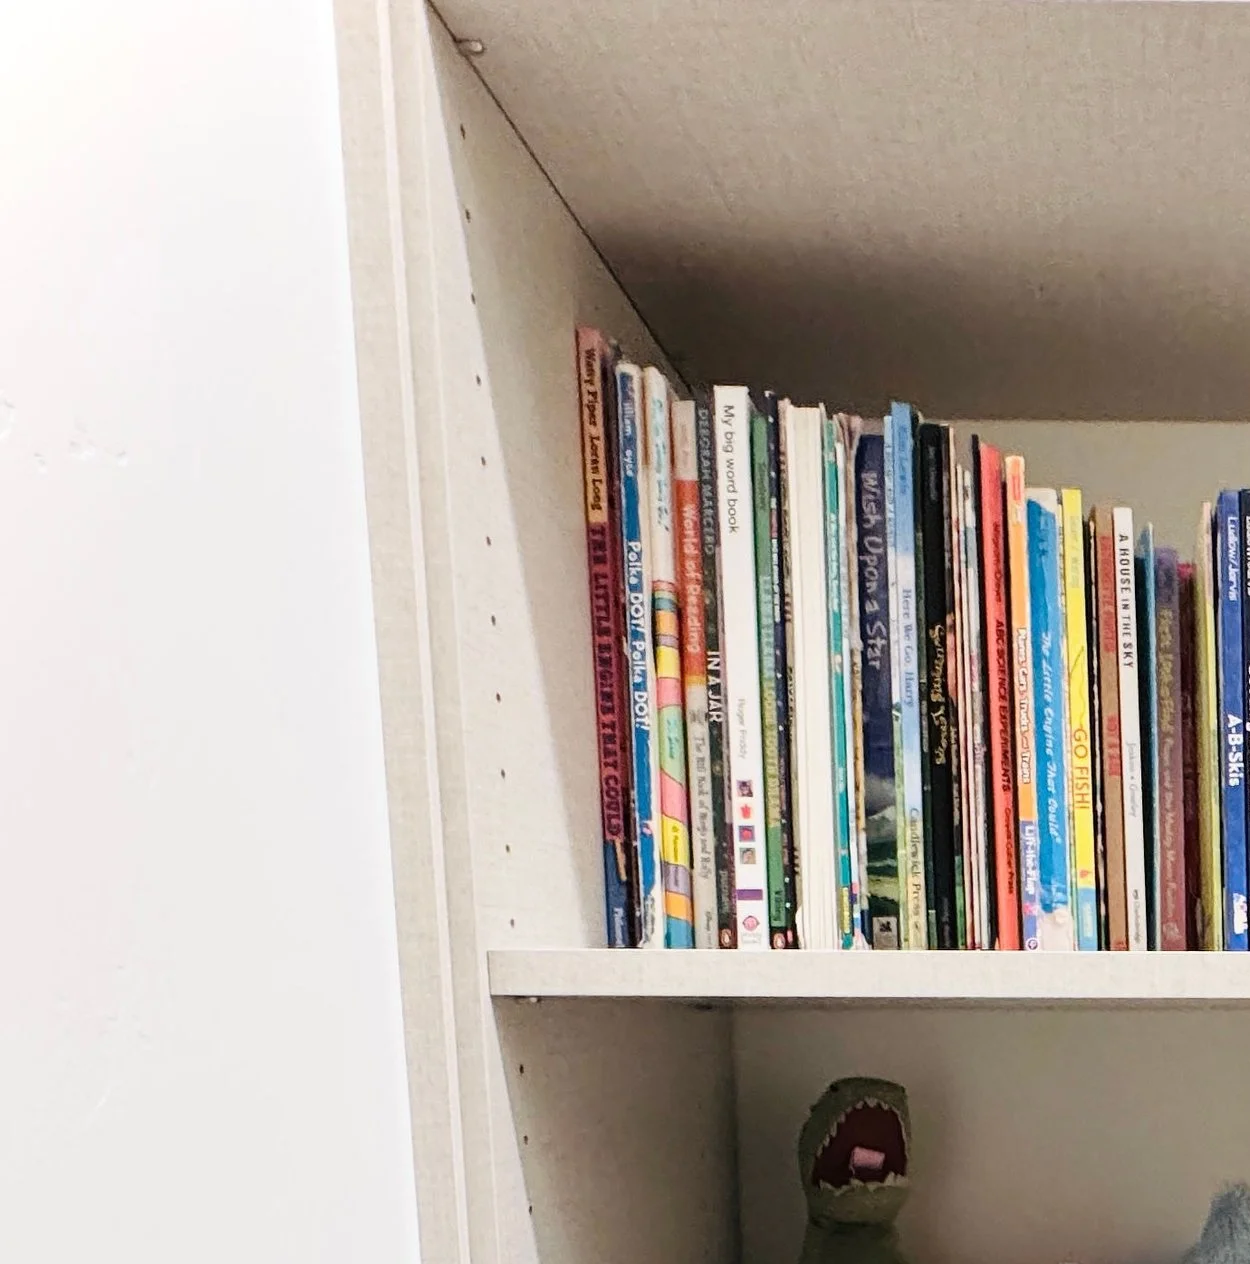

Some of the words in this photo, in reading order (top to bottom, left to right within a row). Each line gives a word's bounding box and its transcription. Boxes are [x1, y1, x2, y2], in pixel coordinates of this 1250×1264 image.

[586, 391, 598, 427] Piper
[720, 405, 735, 426] My
[589, 435, 602, 474] Loren
[698, 407, 712, 480] DEBORAH
[722, 431, 738, 453] big
[726, 458, 739, 493] word
[592, 478, 605, 512] Long
[861, 471, 880, 529] Wish
[683, 504, 698, 554] World
[728, 498, 741, 534] book
[591, 526, 606, 566] THE
[1119, 534, 1128, 543] A
[628, 540, 644, 584] Polka
[686, 561, 698, 578] of
[859, 536, 881, 591] Upon
[1119, 548, 1131, 594] HOUSE
[1227, 516, 1239, 601] Ludlow/Jarvis
[594, 574, 611, 636] LITTLE
[630, 592, 647, 633] DOT!
[685, 584, 702, 654] Reading
[864, 599, 878, 613] a
[901, 588, 913, 619] Here
[1121, 598, 1131, 610] IN
[903, 623, 913, 642] We
[996, 620, 1007, 647] ABC
[1041, 632, 1052, 656] The
[1122, 615, 1132, 638] THE
[631, 640, 646, 684] Polka
[706, 650, 722, 671] IN
[866, 621, 886, 670] Star
[1122, 642, 1134, 670] SKY
[597, 643, 615, 715] ENGINE
[708, 674, 721, 687] A
[902, 672, 916, 708] Harry
[997, 649, 1009, 702] SCIENCE
[1042, 659, 1054, 702] Little
[634, 690, 650, 730] DOT!
[707, 689, 724, 723] JAR
[736, 698, 748, 726] Roger
[601, 720, 617, 770] THAT
[695, 736, 705, 752] The
[737, 729, 749, 759] Priddy
[998, 705, 1012, 792] EXPERIMENTS
[1043, 706, 1056, 756] Engine
[1074, 727, 1088, 759] GO
[1022, 751, 1032, 784] Trains
[1227, 713, 1243, 787] A-B-Skis
[1046, 760, 1057, 793] That
[1075, 765, 1090, 810] FISH!
[604, 774, 621, 837] COULD
[909, 807, 922, 878] Candlewick
[1023, 825, 1037, 895] Lift-the-Flap
[912, 882, 922, 916] Press
